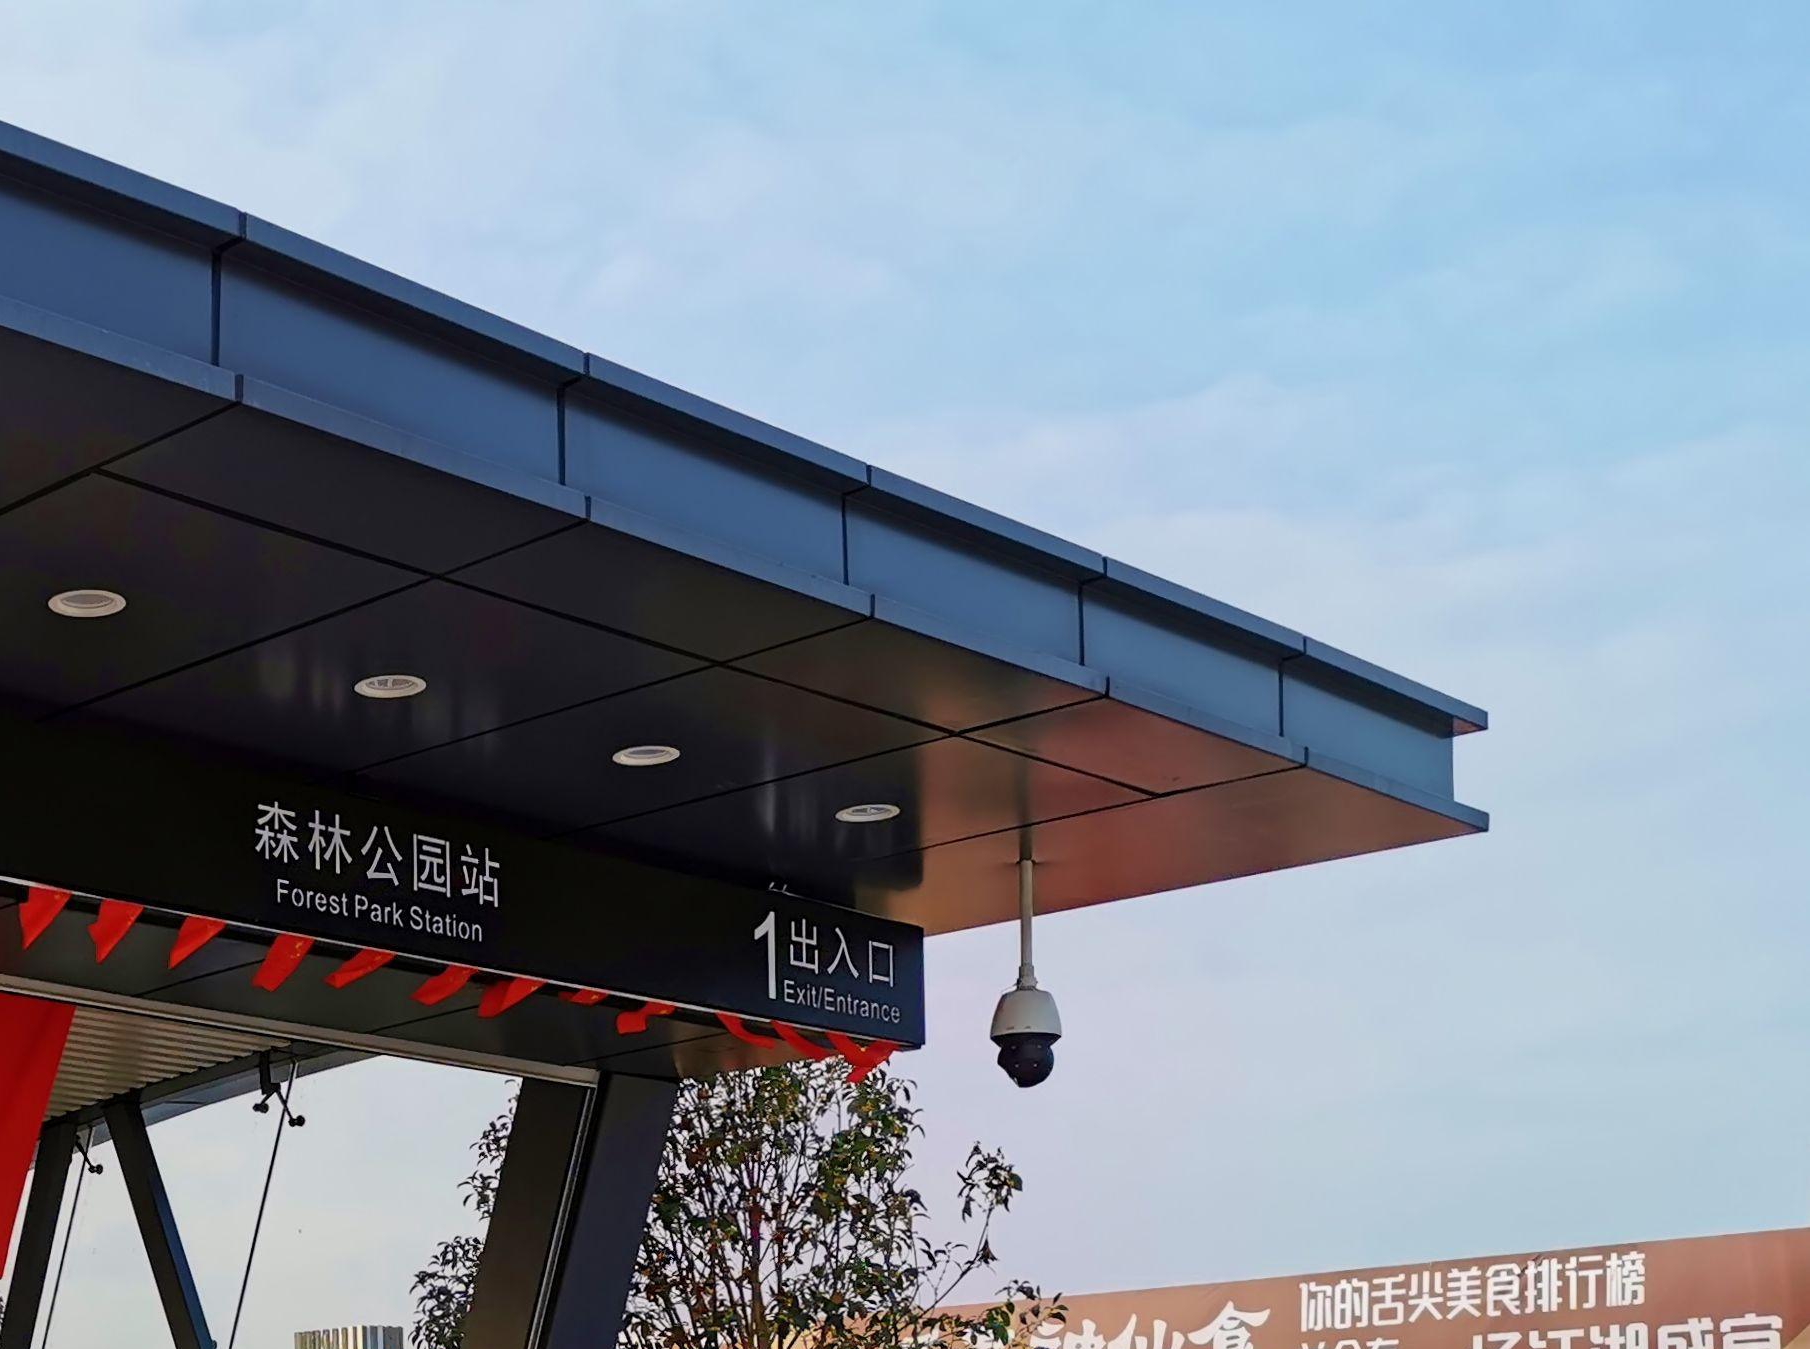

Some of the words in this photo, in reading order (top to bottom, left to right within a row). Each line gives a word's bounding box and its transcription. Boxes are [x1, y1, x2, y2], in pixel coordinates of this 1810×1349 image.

[255, 801, 500, 908] 森林公园站
[277, 879, 348, 916] Forest
[355, 895, 404, 927] Park
[410, 905, 483, 942] Station
[783, 979, 901, 1023] Exit/Entrance
[1299, 1250, 1647, 1333] 你的舌尖美食排行榜
